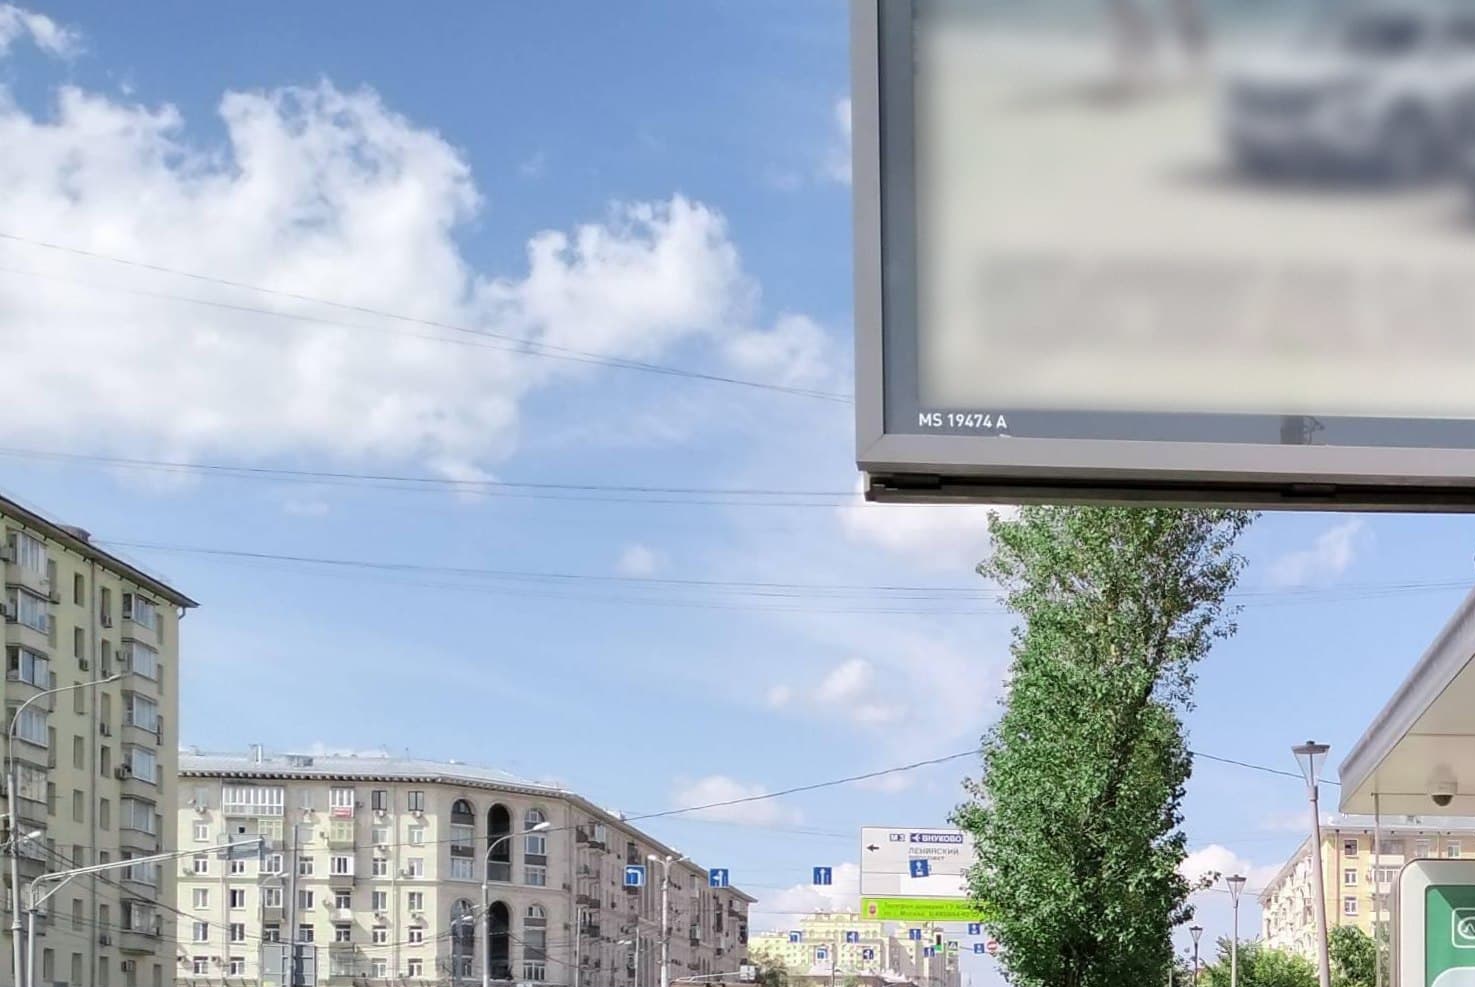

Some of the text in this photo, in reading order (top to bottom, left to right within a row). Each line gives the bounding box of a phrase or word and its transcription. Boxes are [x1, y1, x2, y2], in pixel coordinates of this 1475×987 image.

[918, 412, 1008, 429] MS 19474 A
[921, 834, 962, 843] ВНУКОВО
